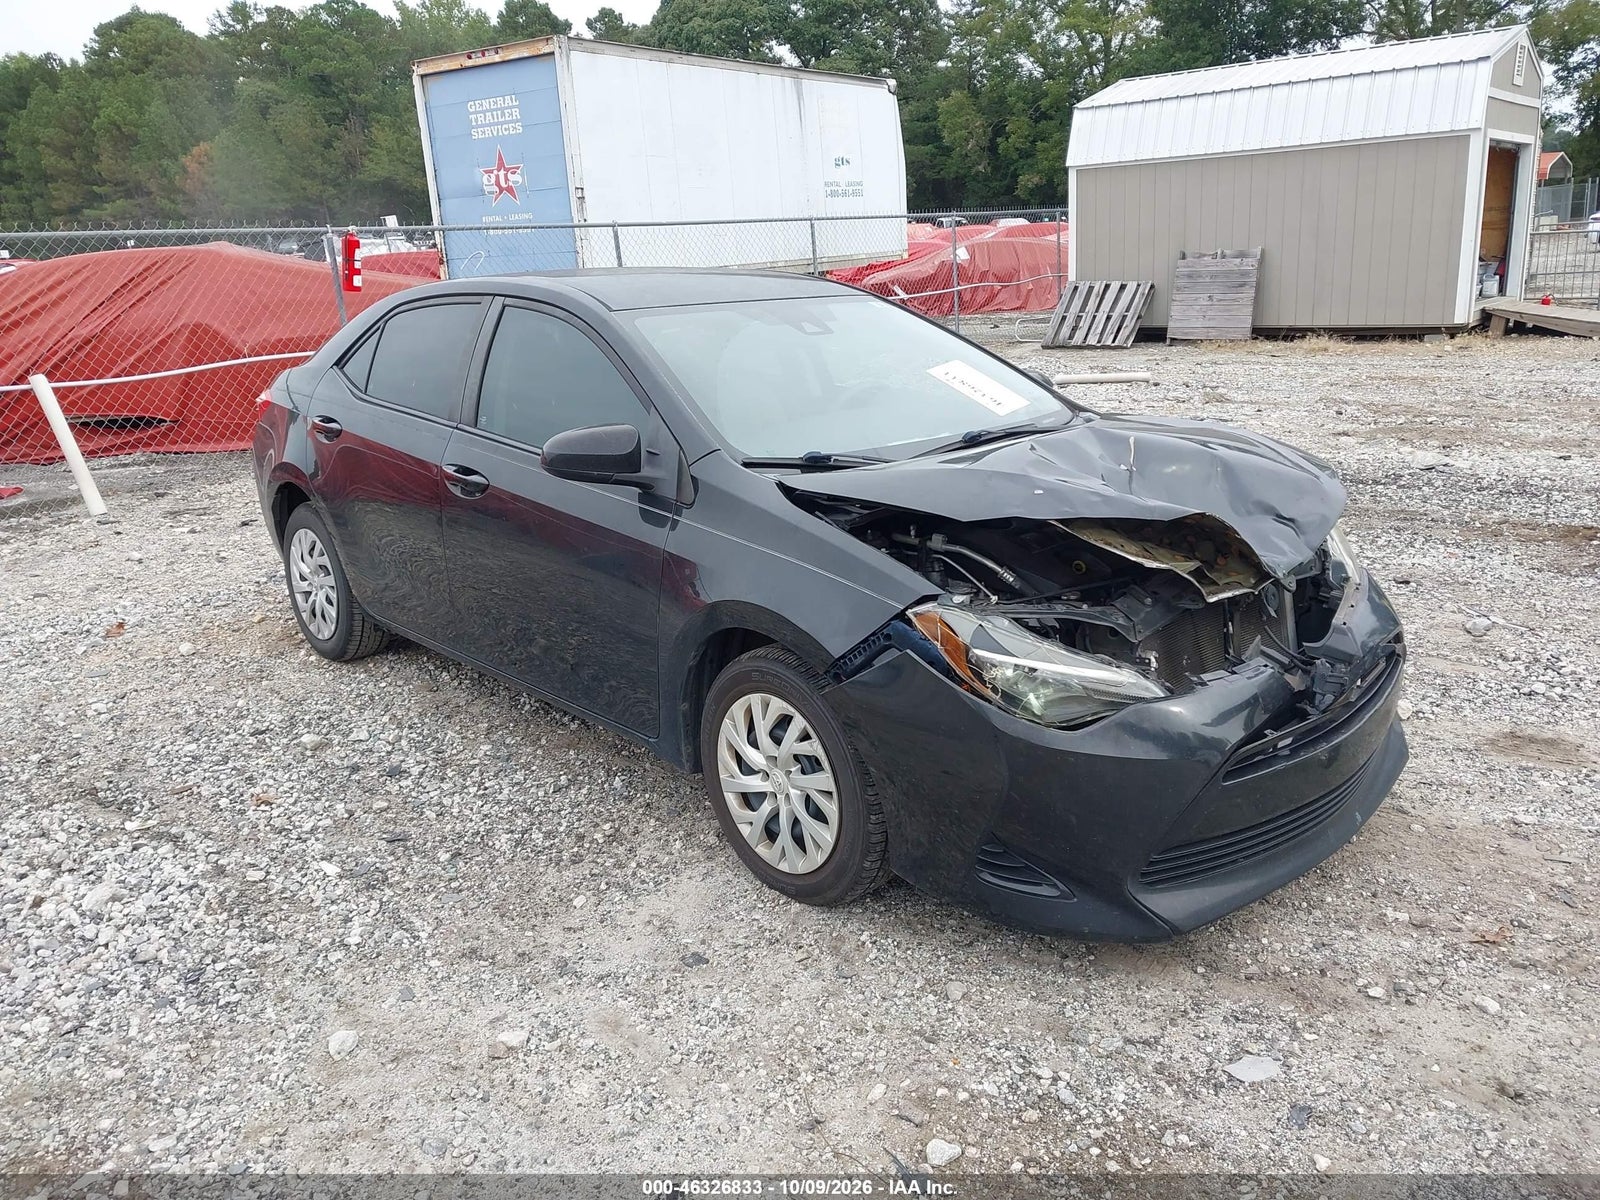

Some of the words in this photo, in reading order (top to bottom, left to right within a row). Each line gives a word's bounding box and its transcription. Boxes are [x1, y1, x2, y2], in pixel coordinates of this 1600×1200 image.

[467, 95, 519, 112] GENERAL
[469, 108, 520, 126] TRAILER
[471, 122, 523, 140] SERVICES
[834, 156, 850, 169] gts
[482, 168, 523, 197] gts
[824, 180, 841, 188] RENTAL
[844, 180, 864, 188] LEASING
[482, 215, 502, 223] RENTAL
[508, 212, 533, 221] LEASING
